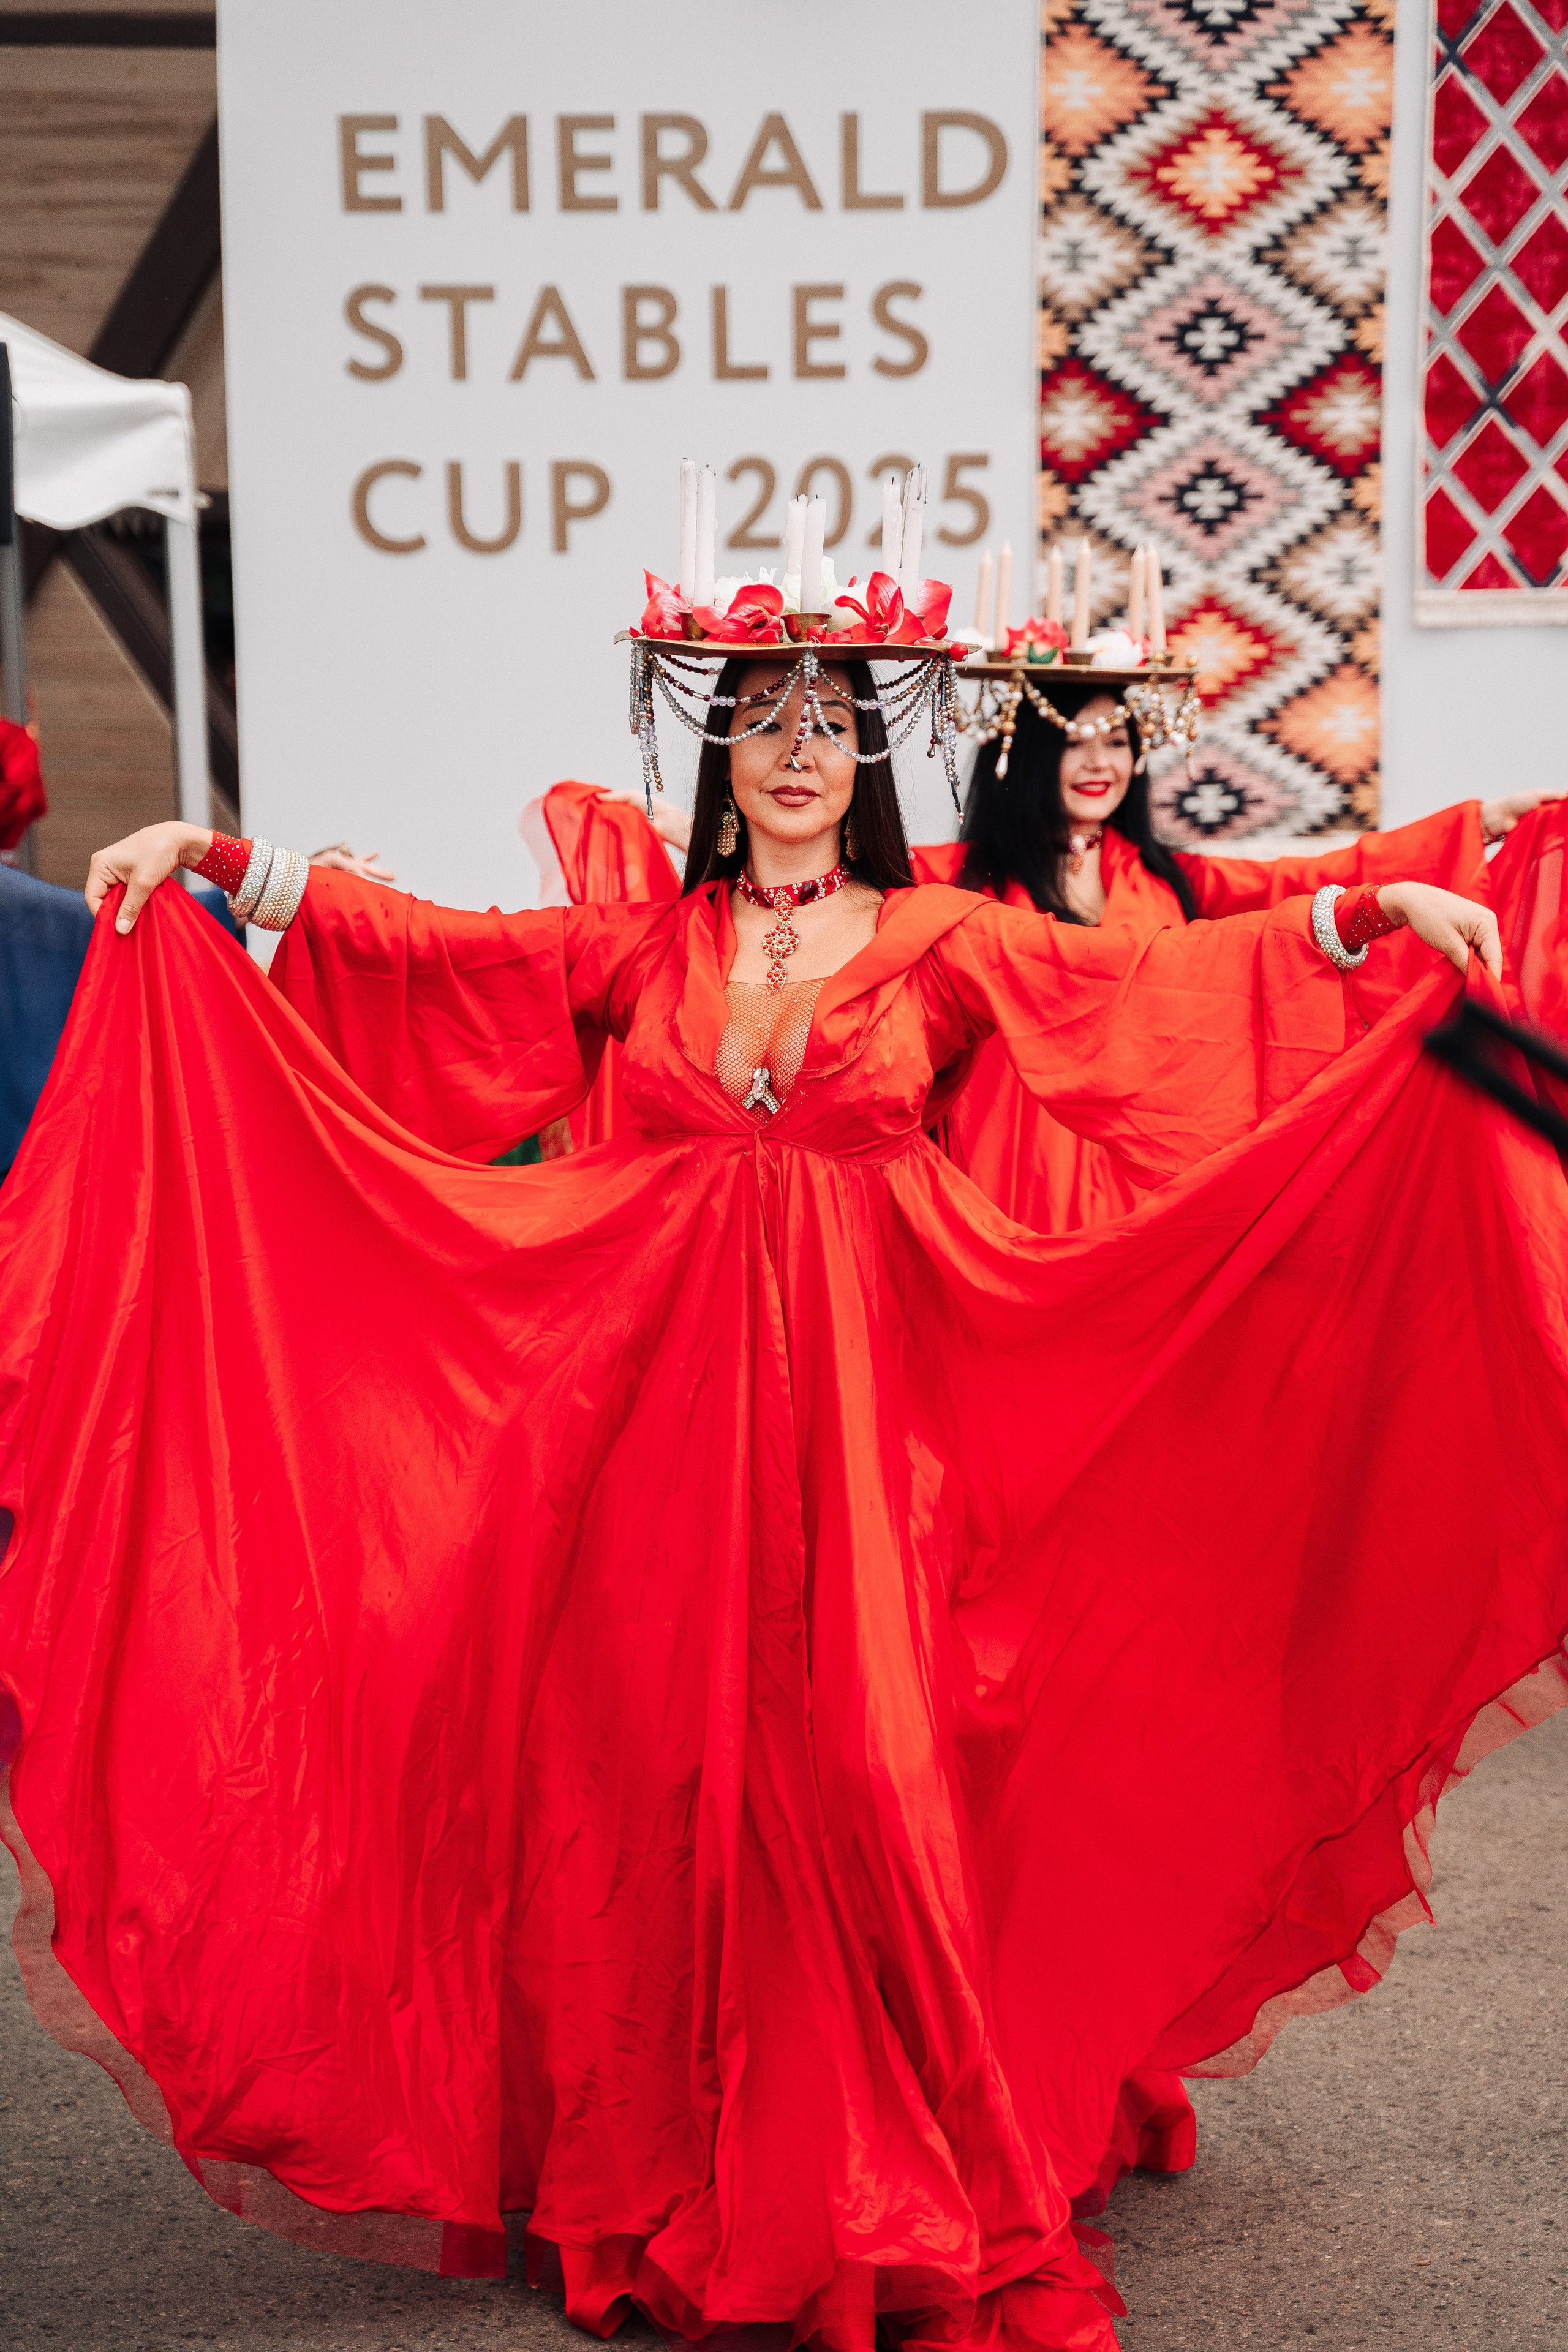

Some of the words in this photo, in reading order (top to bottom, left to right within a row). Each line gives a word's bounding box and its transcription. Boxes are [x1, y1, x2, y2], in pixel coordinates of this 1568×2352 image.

[336, 109, 1011, 216] EMERALD
[343, 280, 930, 384] STABLES
[350, 458, 612, 557] CUP
